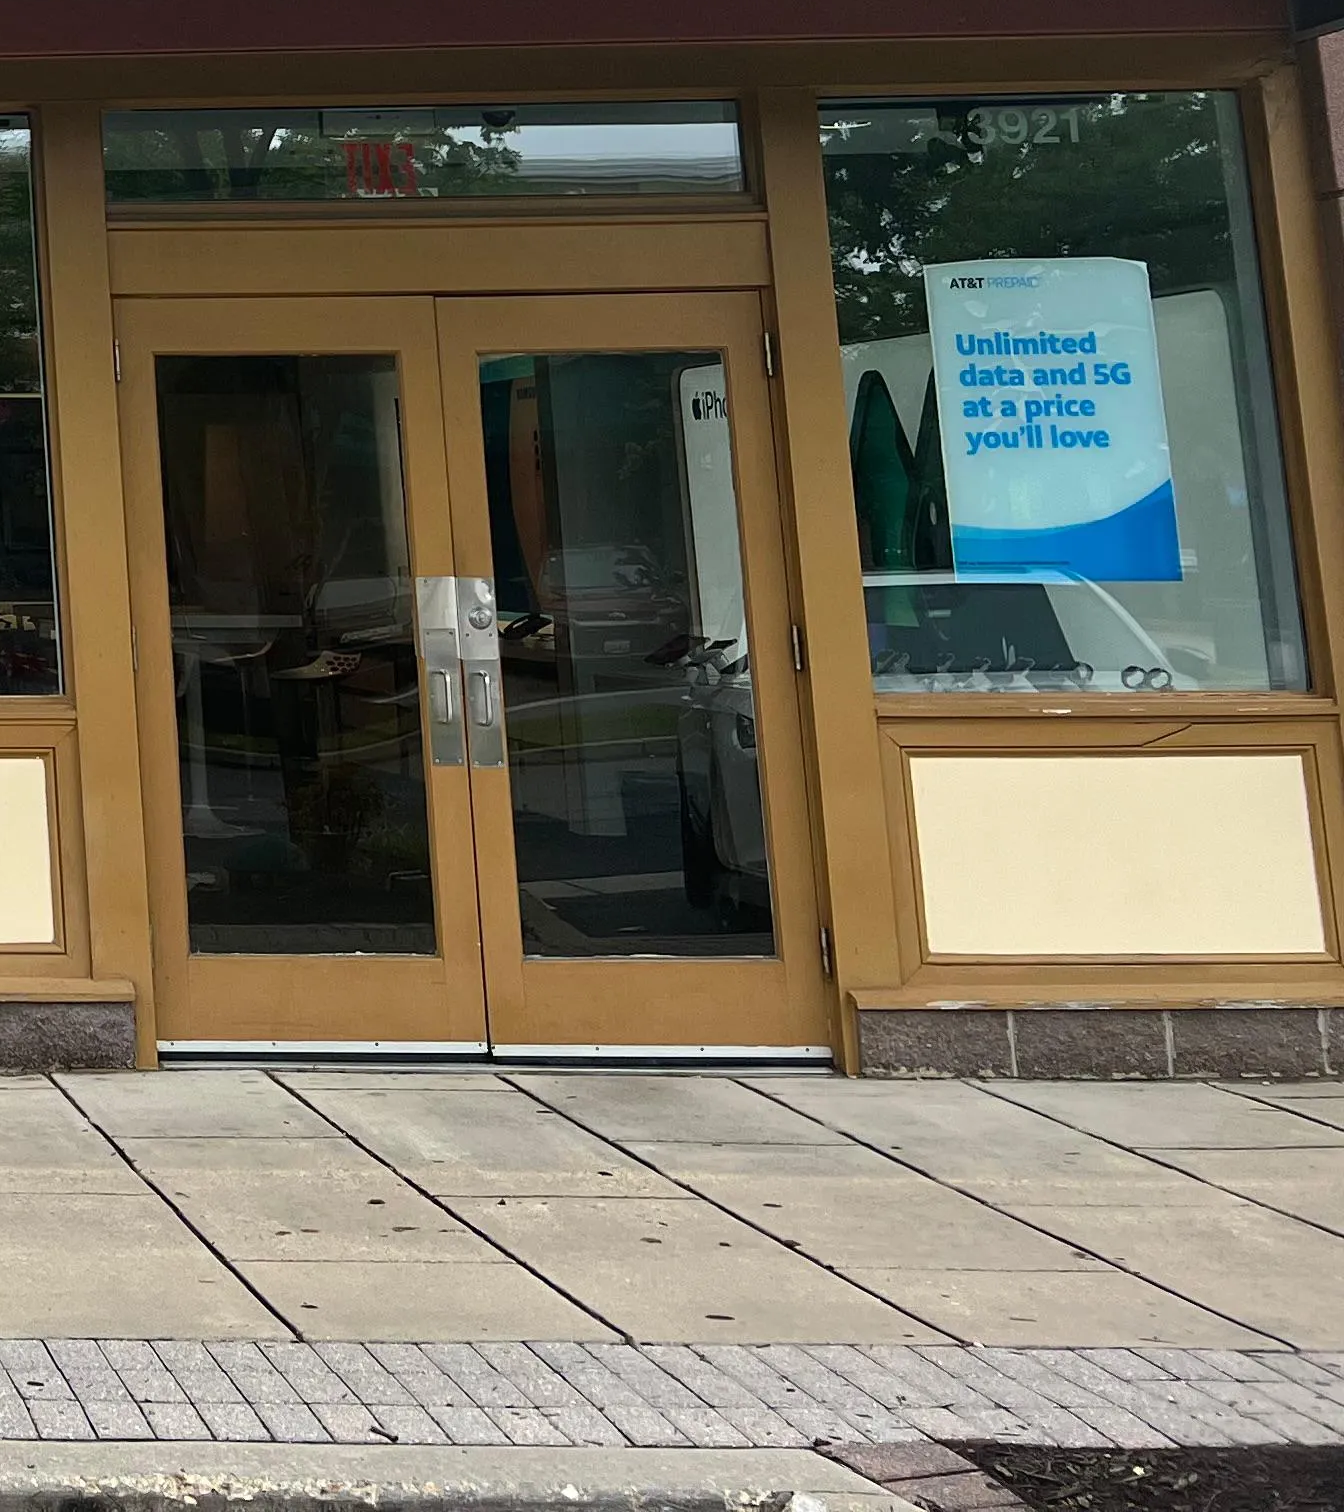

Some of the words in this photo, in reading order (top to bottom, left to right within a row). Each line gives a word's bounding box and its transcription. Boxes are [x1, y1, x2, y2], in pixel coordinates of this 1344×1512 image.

[967, 108, 1080, 145] 3921
[949, 277, 985, 290] AT&T
[955, 331, 1097, 356] Unlimited
[959, 362, 1025, 387] data
[1032, 362, 1087, 386] and
[1093, 361, 1132, 386] 5G
[963, 396, 994, 418] at
[1000, 398, 1018, 418] a
[1024, 393, 1096, 424] price
[964, 424, 1043, 456] you'll
[1049, 424, 1110, 449] love
